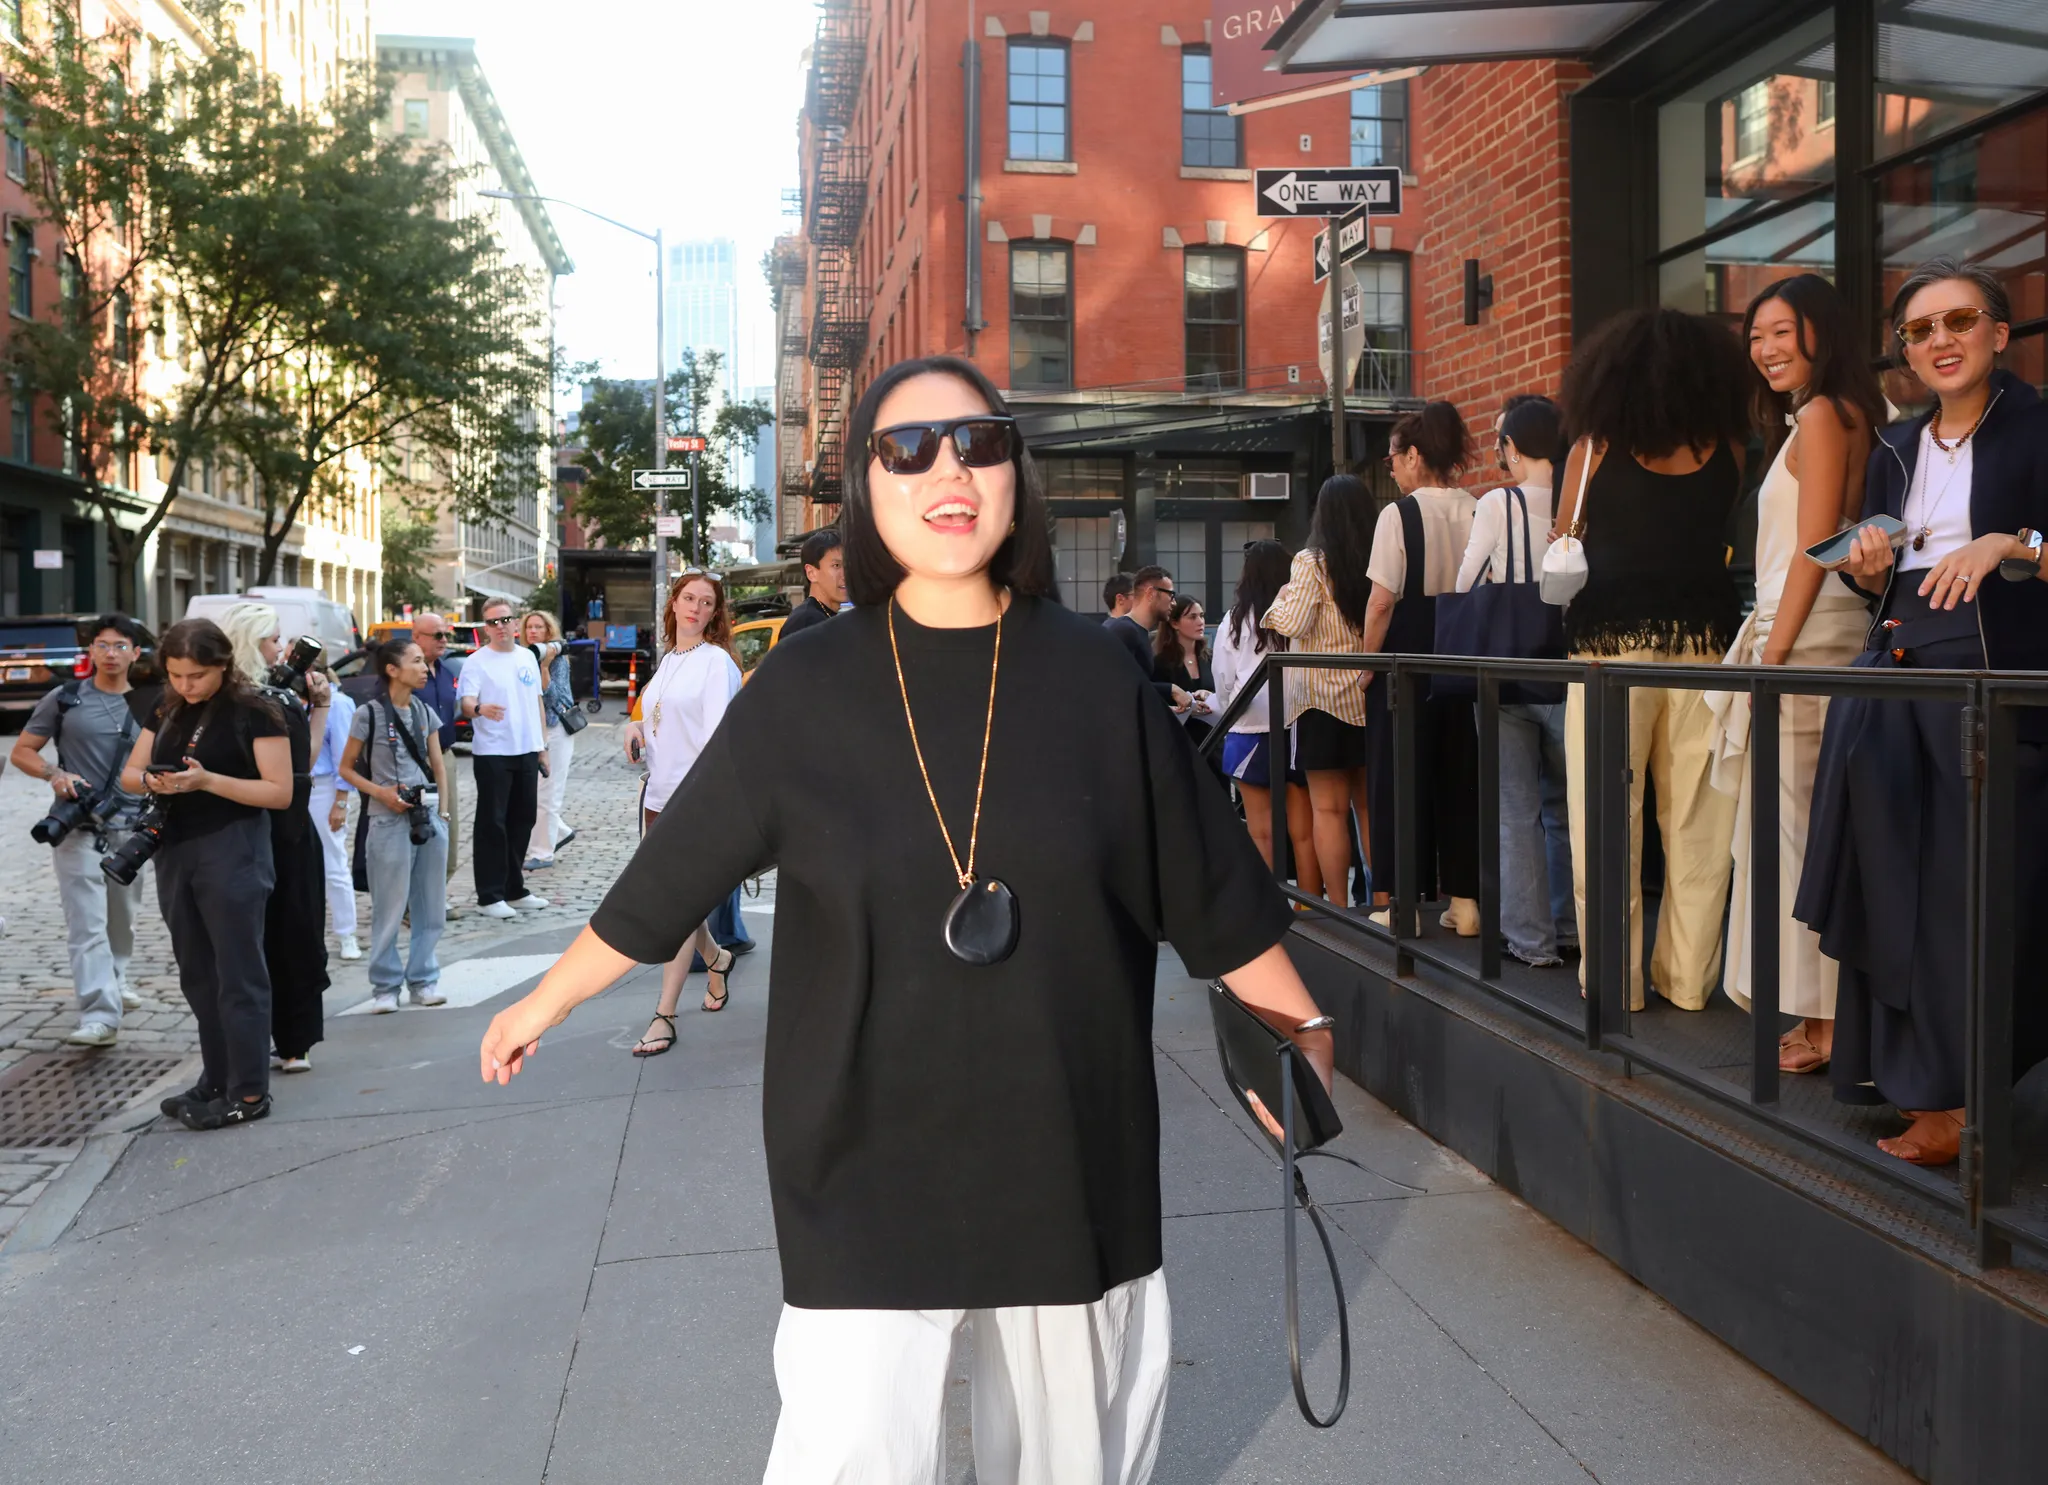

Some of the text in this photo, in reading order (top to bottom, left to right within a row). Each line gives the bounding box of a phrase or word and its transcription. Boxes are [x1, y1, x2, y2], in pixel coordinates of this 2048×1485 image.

[1279, 183, 1381, 202] ONE WAY
[1341, 222, 1360, 248] WAY
[668, 438, 699, 451] Vestry St
[641, 475, 683, 484] ONE WAY
